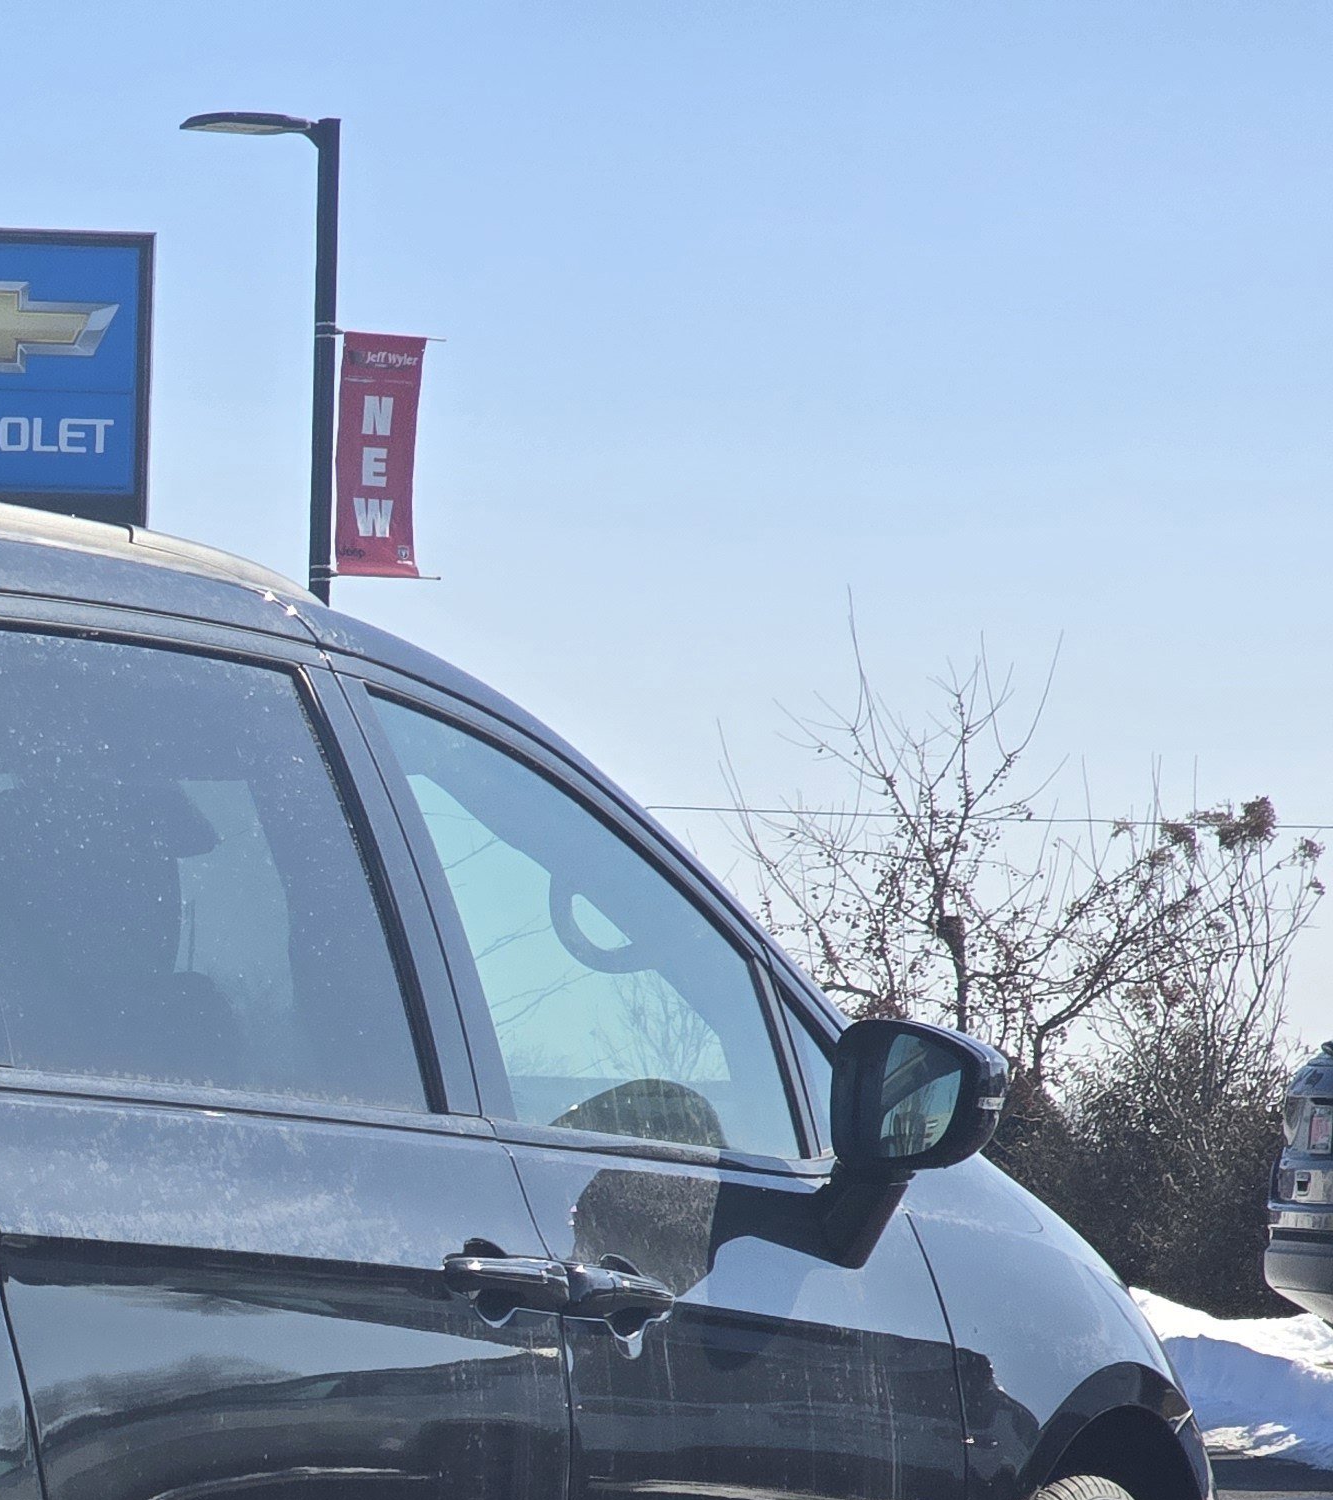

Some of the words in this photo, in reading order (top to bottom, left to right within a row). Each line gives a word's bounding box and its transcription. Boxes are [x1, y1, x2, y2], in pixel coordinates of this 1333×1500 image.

[364, 350, 387, 365] Jeff
[387, 352, 419, 368] Wyler
[353, 395, 393, 537] NEW
